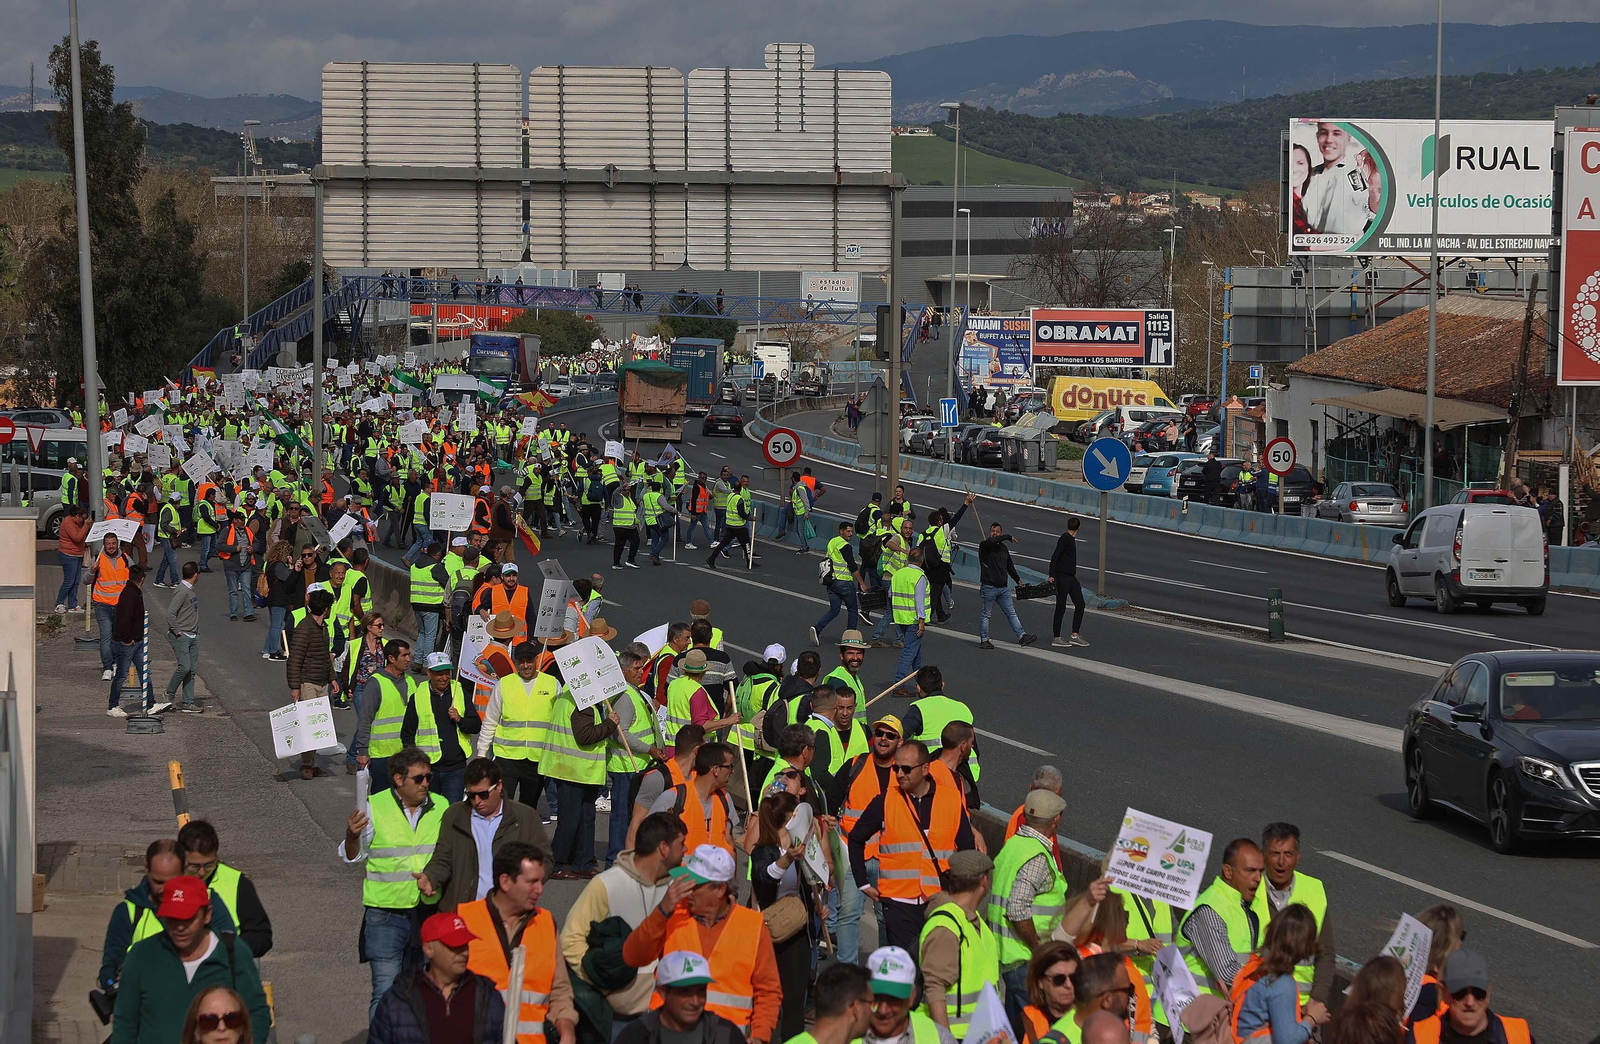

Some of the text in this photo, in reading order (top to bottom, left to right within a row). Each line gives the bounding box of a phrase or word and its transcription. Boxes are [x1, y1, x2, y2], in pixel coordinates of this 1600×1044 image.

[1456, 146, 1540, 170] RUAL
[1482, 195, 1500, 208] de
[1306, 236, 1356, 244] 626 492 524
[1378, 238, 1395, 248] POL.
[1396, 238, 1412, 248] IND.
[1413, 238, 1424, 248] LA
[1424, 238, 1460, 249] MNACHA
[1467, 238, 1479, 249] AV.
[1480, 238, 1494, 249] DEL
[1496, 239, 1533, 249] ESTRECHO
[1003, 320, 1030, 330] SUSHI
[1146, 321, 1170, 331] 1113
[1038, 325, 1136, 341] OBRAMAT
[1062, 385, 1147, 409] donuts
[772, 441, 793, 454] 50
[1272, 450, 1290, 462] 50
[603, 684, 617, 694] Campo
[1116, 838, 1148, 852] COAG
[1177, 859, 1195, 871] UPA
[1136, 864, 1145, 873] UN
[1146, 867, 1166, 879] CAMPO
